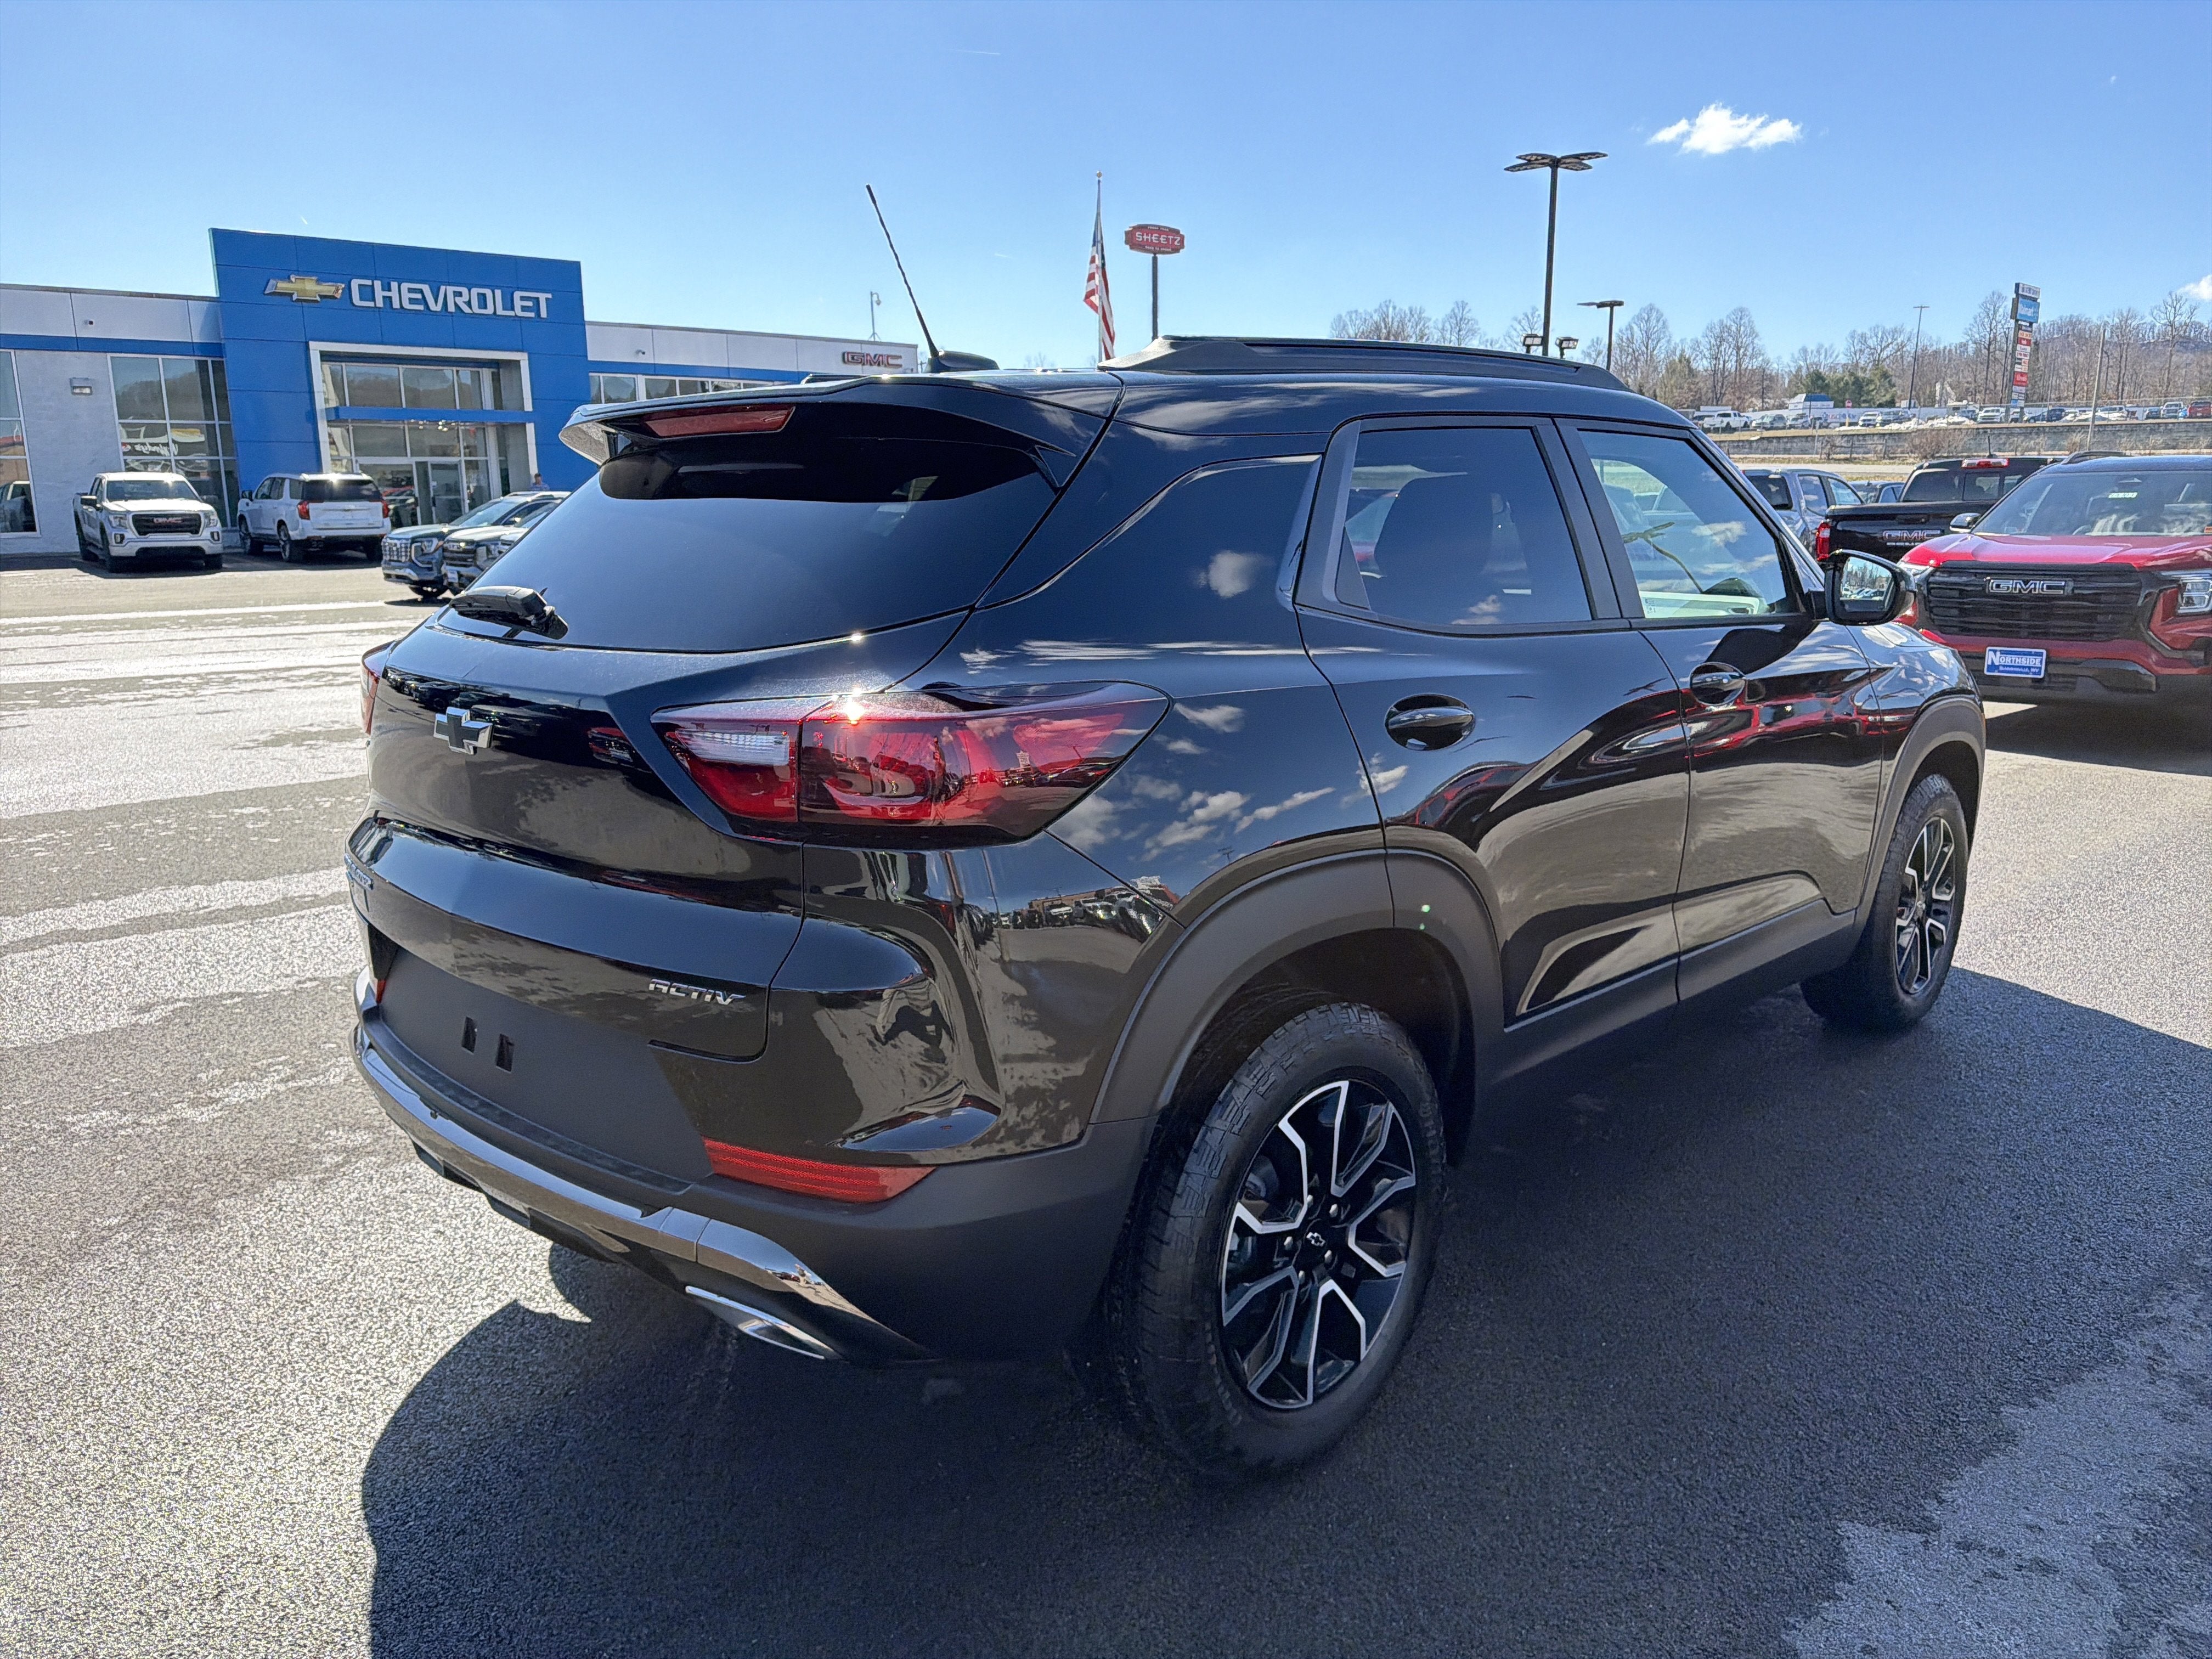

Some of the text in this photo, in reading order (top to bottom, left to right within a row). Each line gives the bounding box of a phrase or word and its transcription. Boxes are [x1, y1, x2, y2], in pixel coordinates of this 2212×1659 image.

[1136, 232, 1181, 246] SHEETZ
[351, 279, 552, 318] CHEVROLET
[842, 351, 902, 369] GMC
[1883, 529, 1940, 540] GMC
[1989, 579, 2065, 594] GMC
[1988, 651, 2041, 665] NORTHSIDE
[648, 979, 746, 1005] ACTIV
